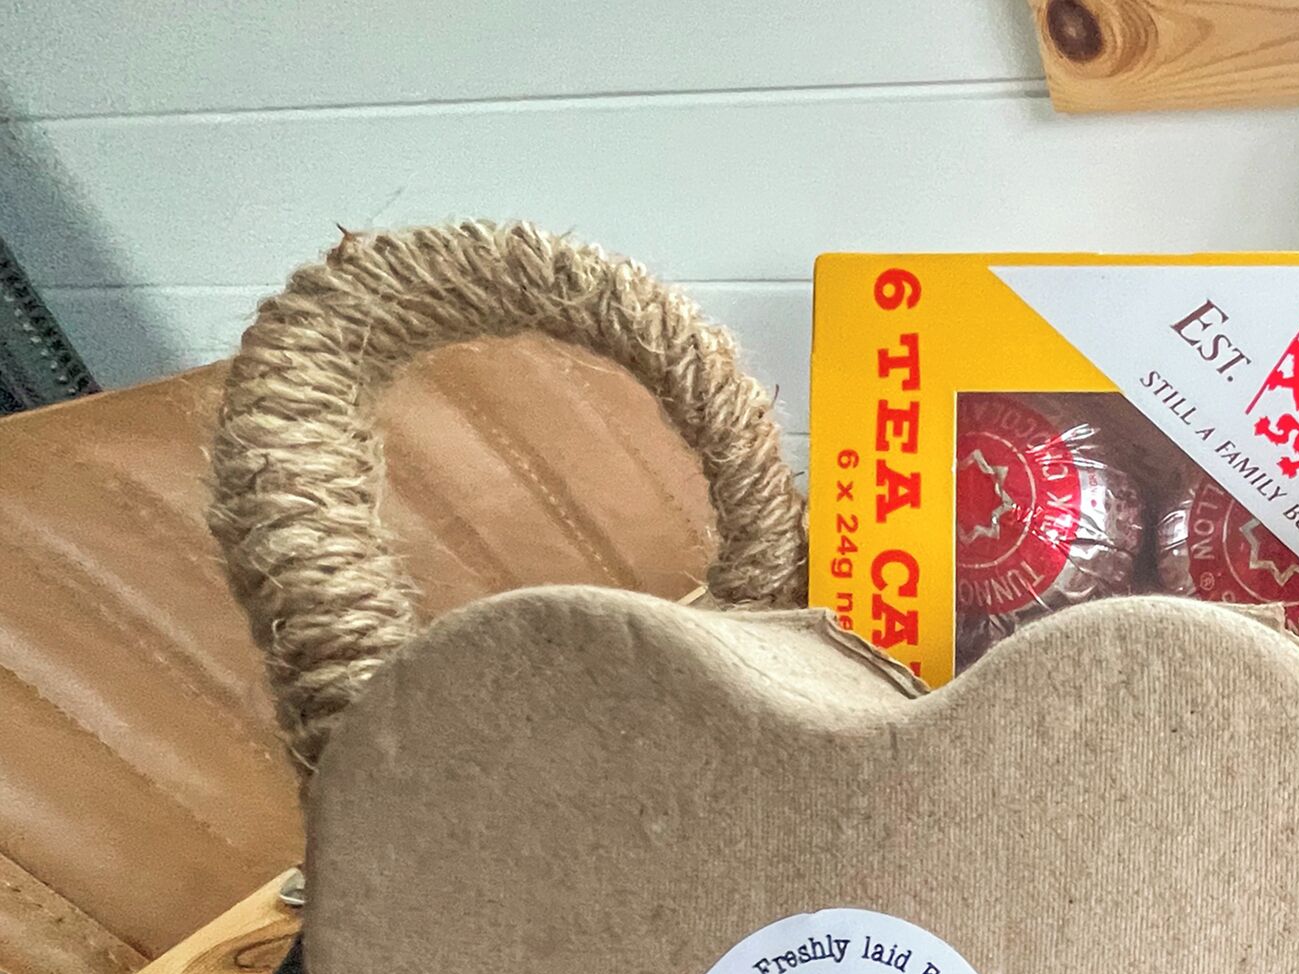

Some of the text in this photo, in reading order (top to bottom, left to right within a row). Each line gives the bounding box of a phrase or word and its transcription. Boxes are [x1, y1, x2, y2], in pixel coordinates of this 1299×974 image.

[836, 448, 860, 470] 6
[1140, 371, 1191, 425] STILL
[1195, 427, 1215, 441] A
[1214, 440, 1287, 502] FAMILY
[837, 480, 854, 501] x
[871, 268, 922, 686] 6 TEA CA
[831, 513, 860, 580] 24g
[861, 936, 912, 973] laid
